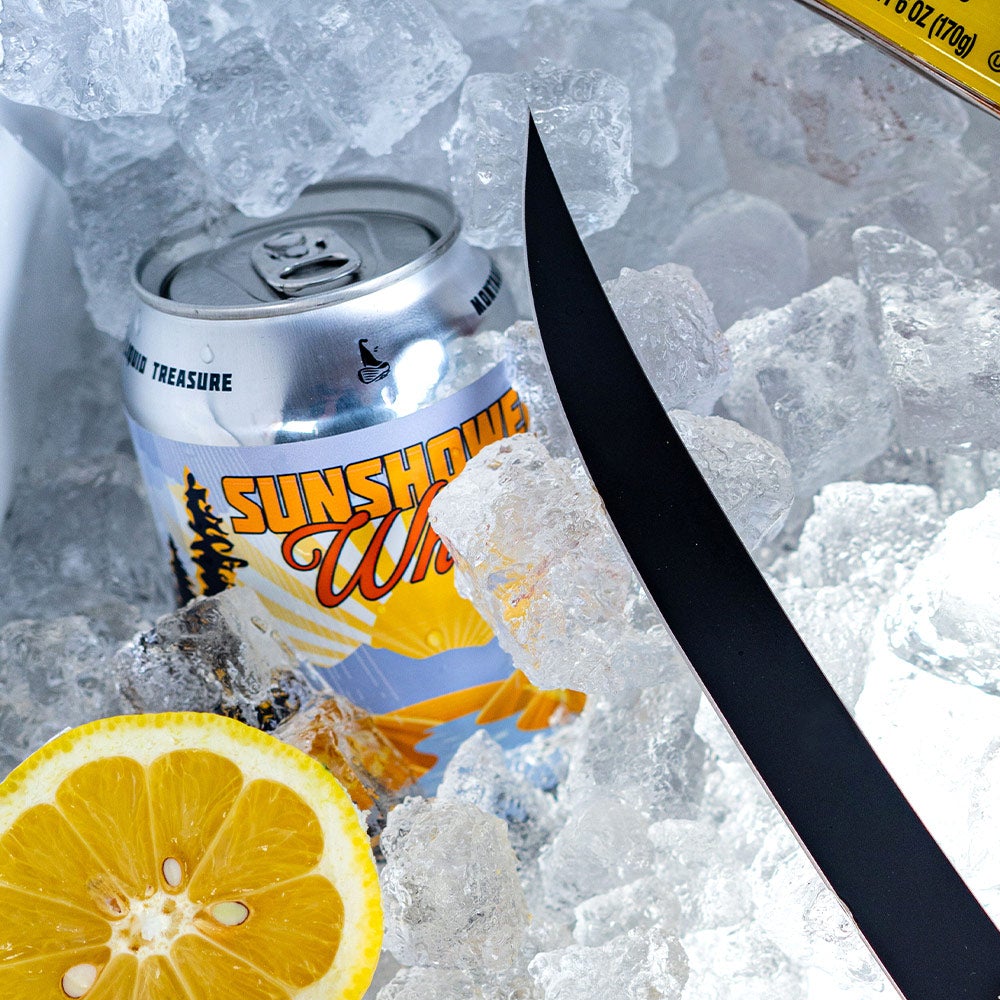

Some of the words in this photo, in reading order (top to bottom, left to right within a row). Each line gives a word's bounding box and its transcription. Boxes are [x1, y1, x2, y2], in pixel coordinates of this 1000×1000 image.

[907, 0, 935, 28] OZ
[927, 13, 977, 59] (170g)
[152, 361, 233, 392] TREASURE
[221, 387, 531, 534] SUNSHOWE
